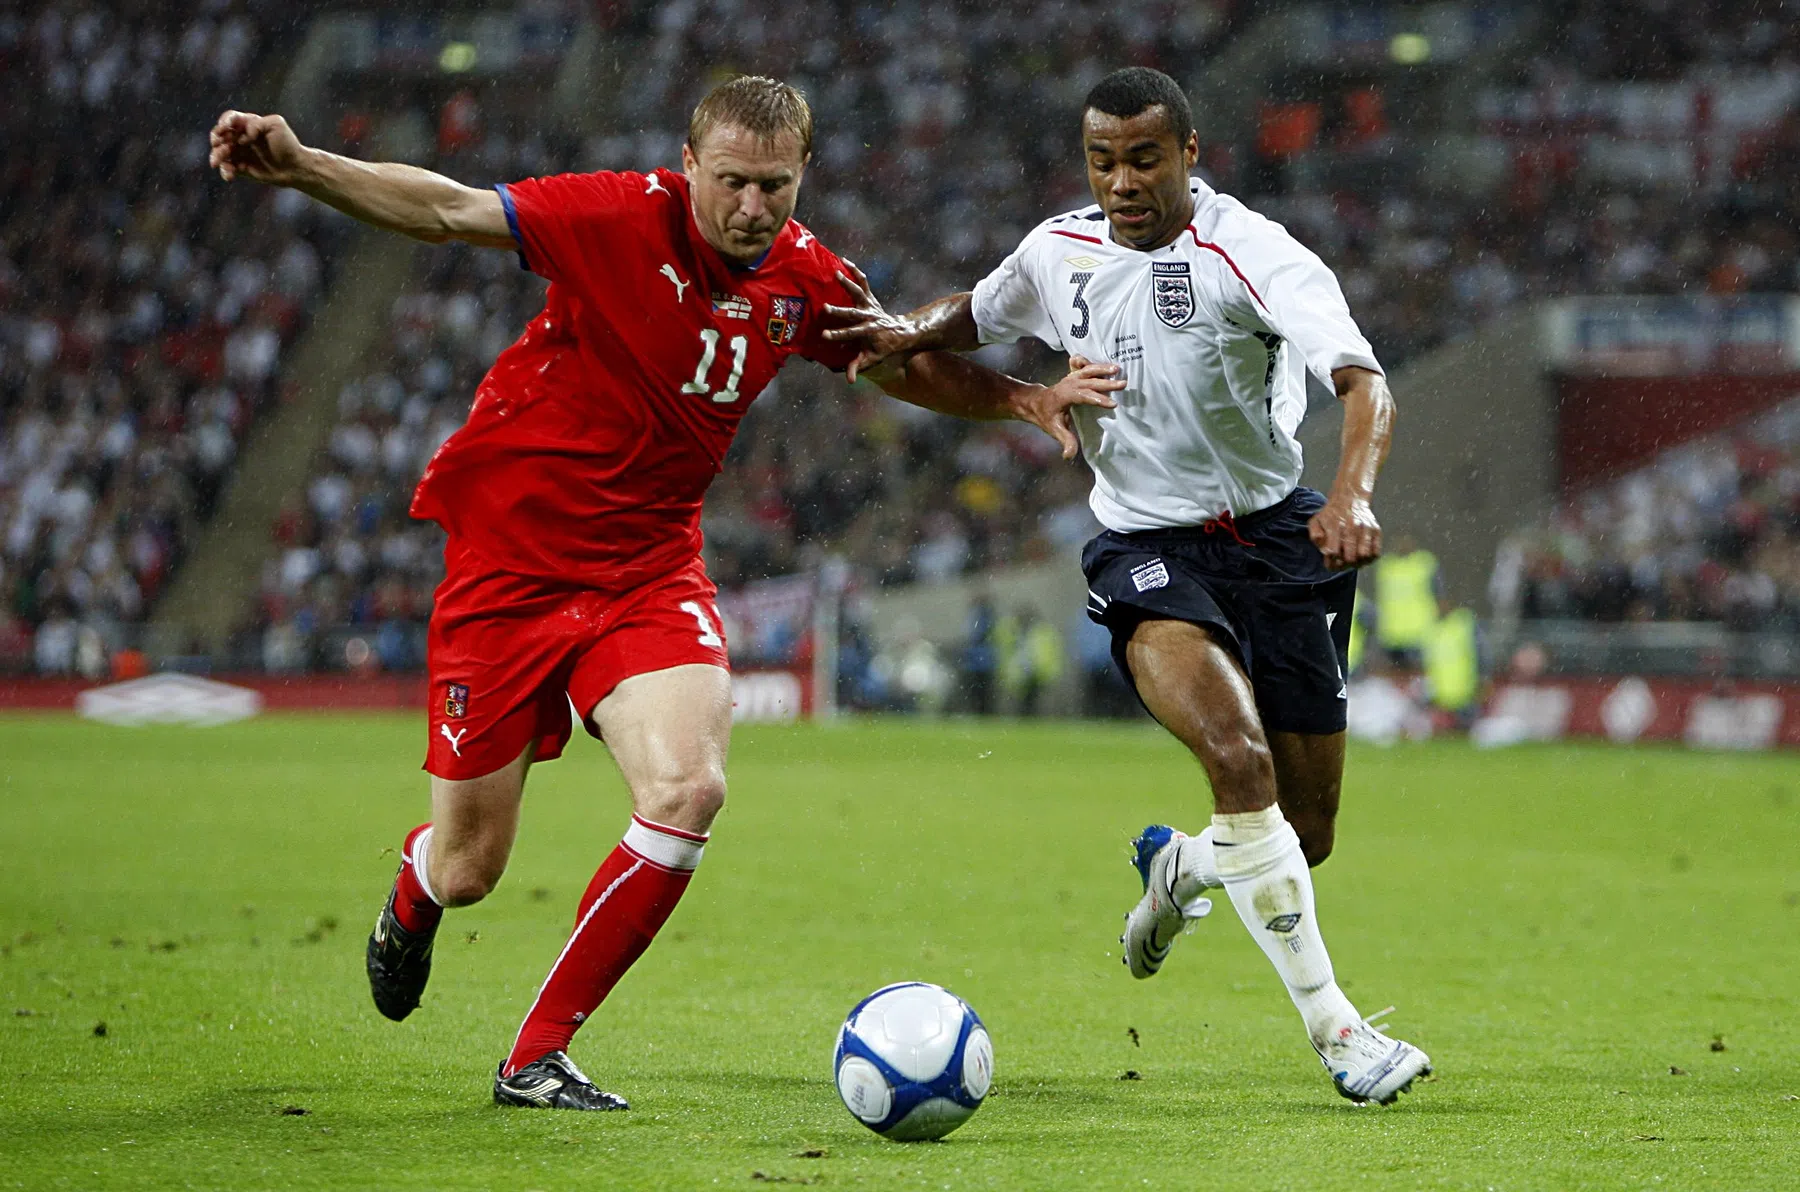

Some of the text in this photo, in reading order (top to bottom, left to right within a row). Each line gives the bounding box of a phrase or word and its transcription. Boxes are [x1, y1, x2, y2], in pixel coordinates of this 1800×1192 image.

[1154, 264, 1187, 272] ENGLAND
[1069, 272, 1094, 339] 3
[681, 328, 748, 402] 11
[1130, 558, 1161, 574] ENGLAND
